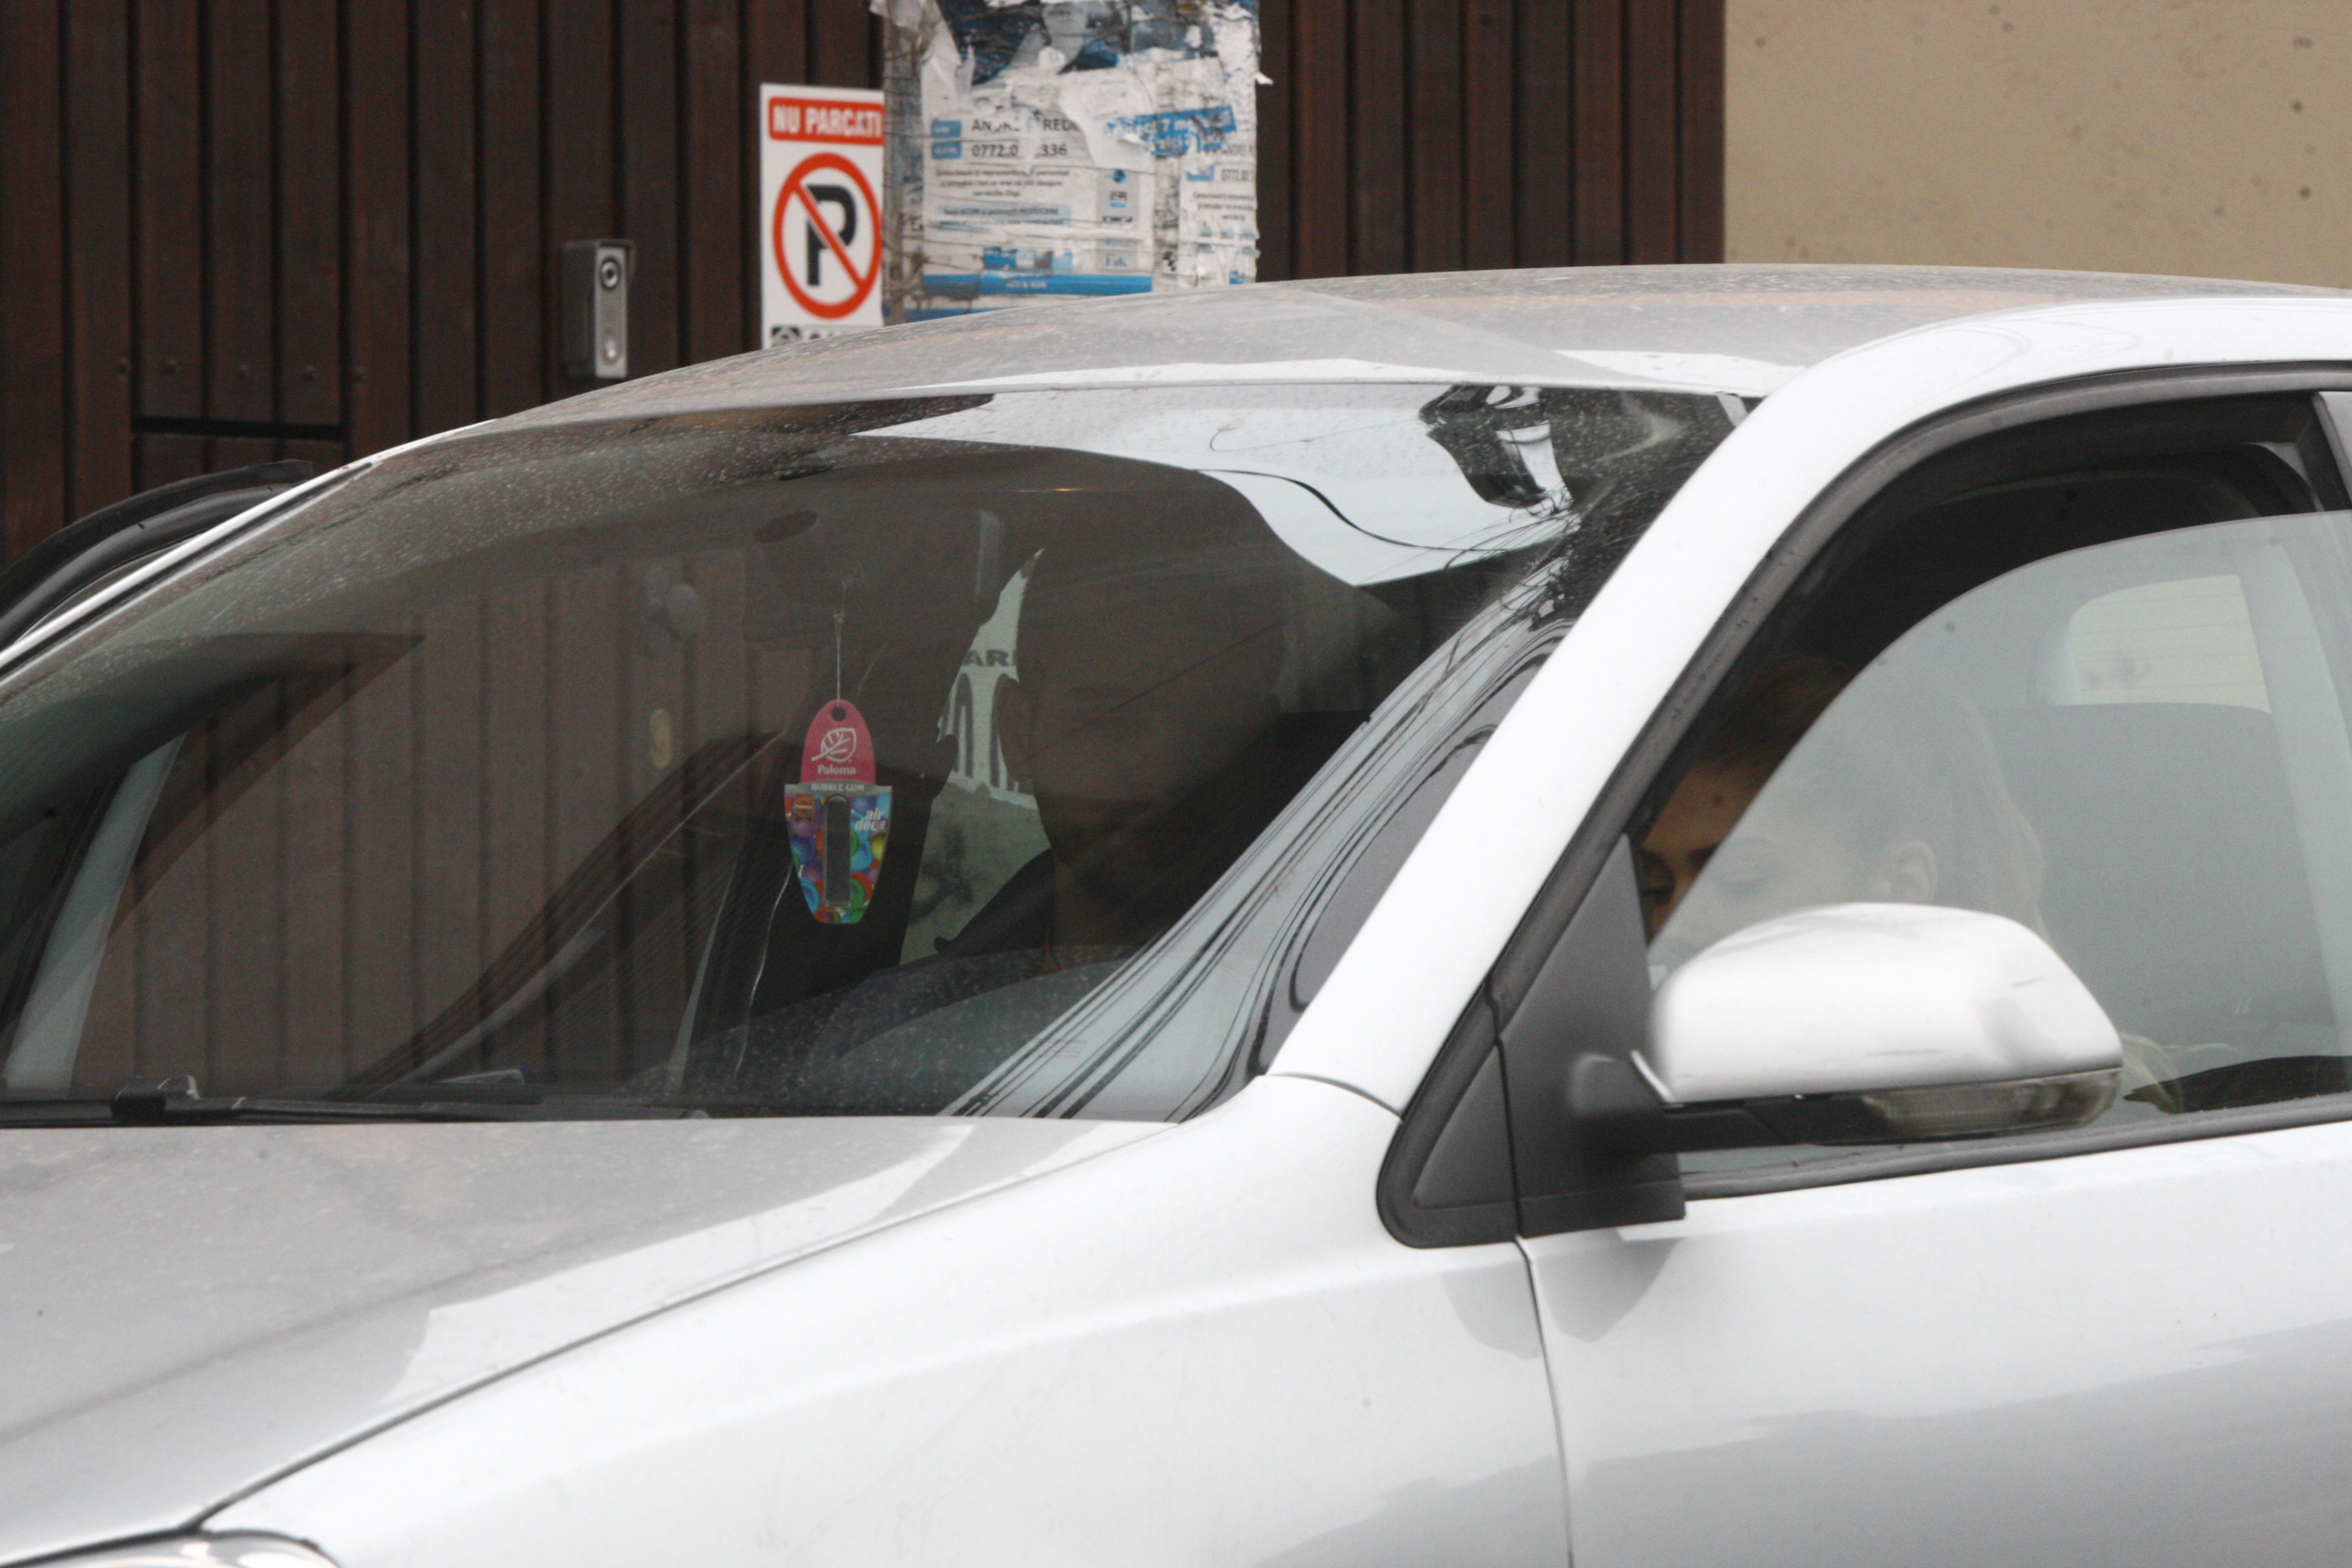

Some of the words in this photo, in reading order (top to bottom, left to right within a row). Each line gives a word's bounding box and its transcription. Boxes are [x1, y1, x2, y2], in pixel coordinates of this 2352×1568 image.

[773, 105, 800, 132] NU
[817, 764, 856, 775] Paloma
[865, 808, 884, 821] air
